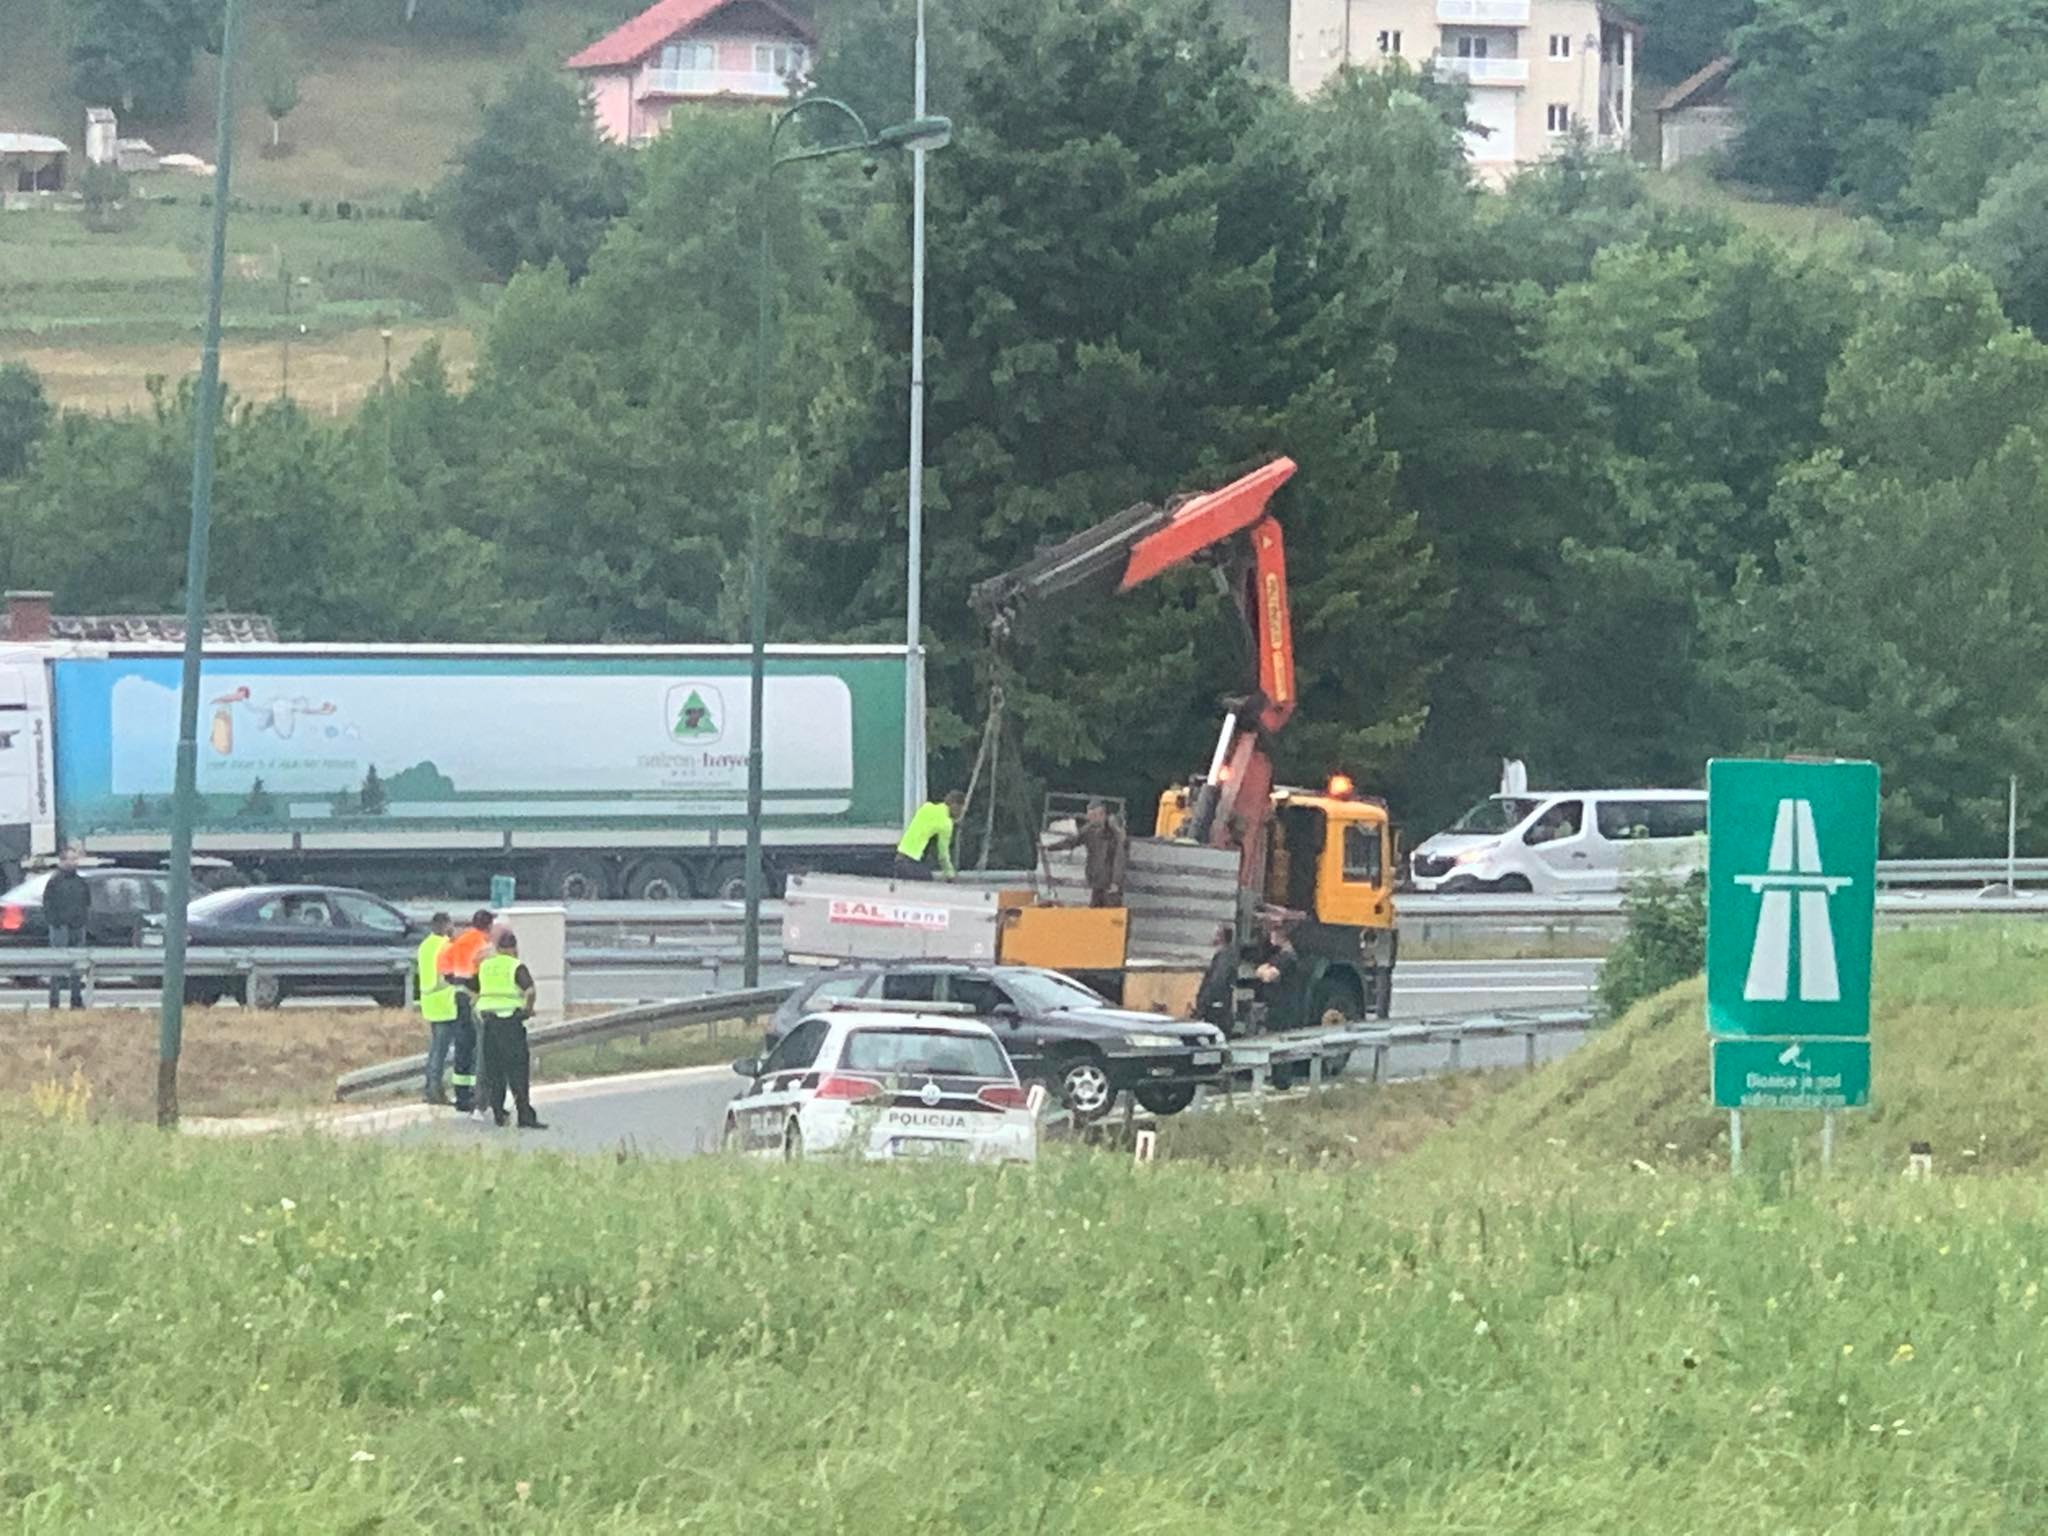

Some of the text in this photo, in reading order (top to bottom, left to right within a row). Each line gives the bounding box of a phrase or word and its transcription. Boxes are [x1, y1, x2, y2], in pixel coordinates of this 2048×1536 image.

[832, 902, 947, 923] SAL trans
[888, 1112, 966, 1127] POLICIJA
